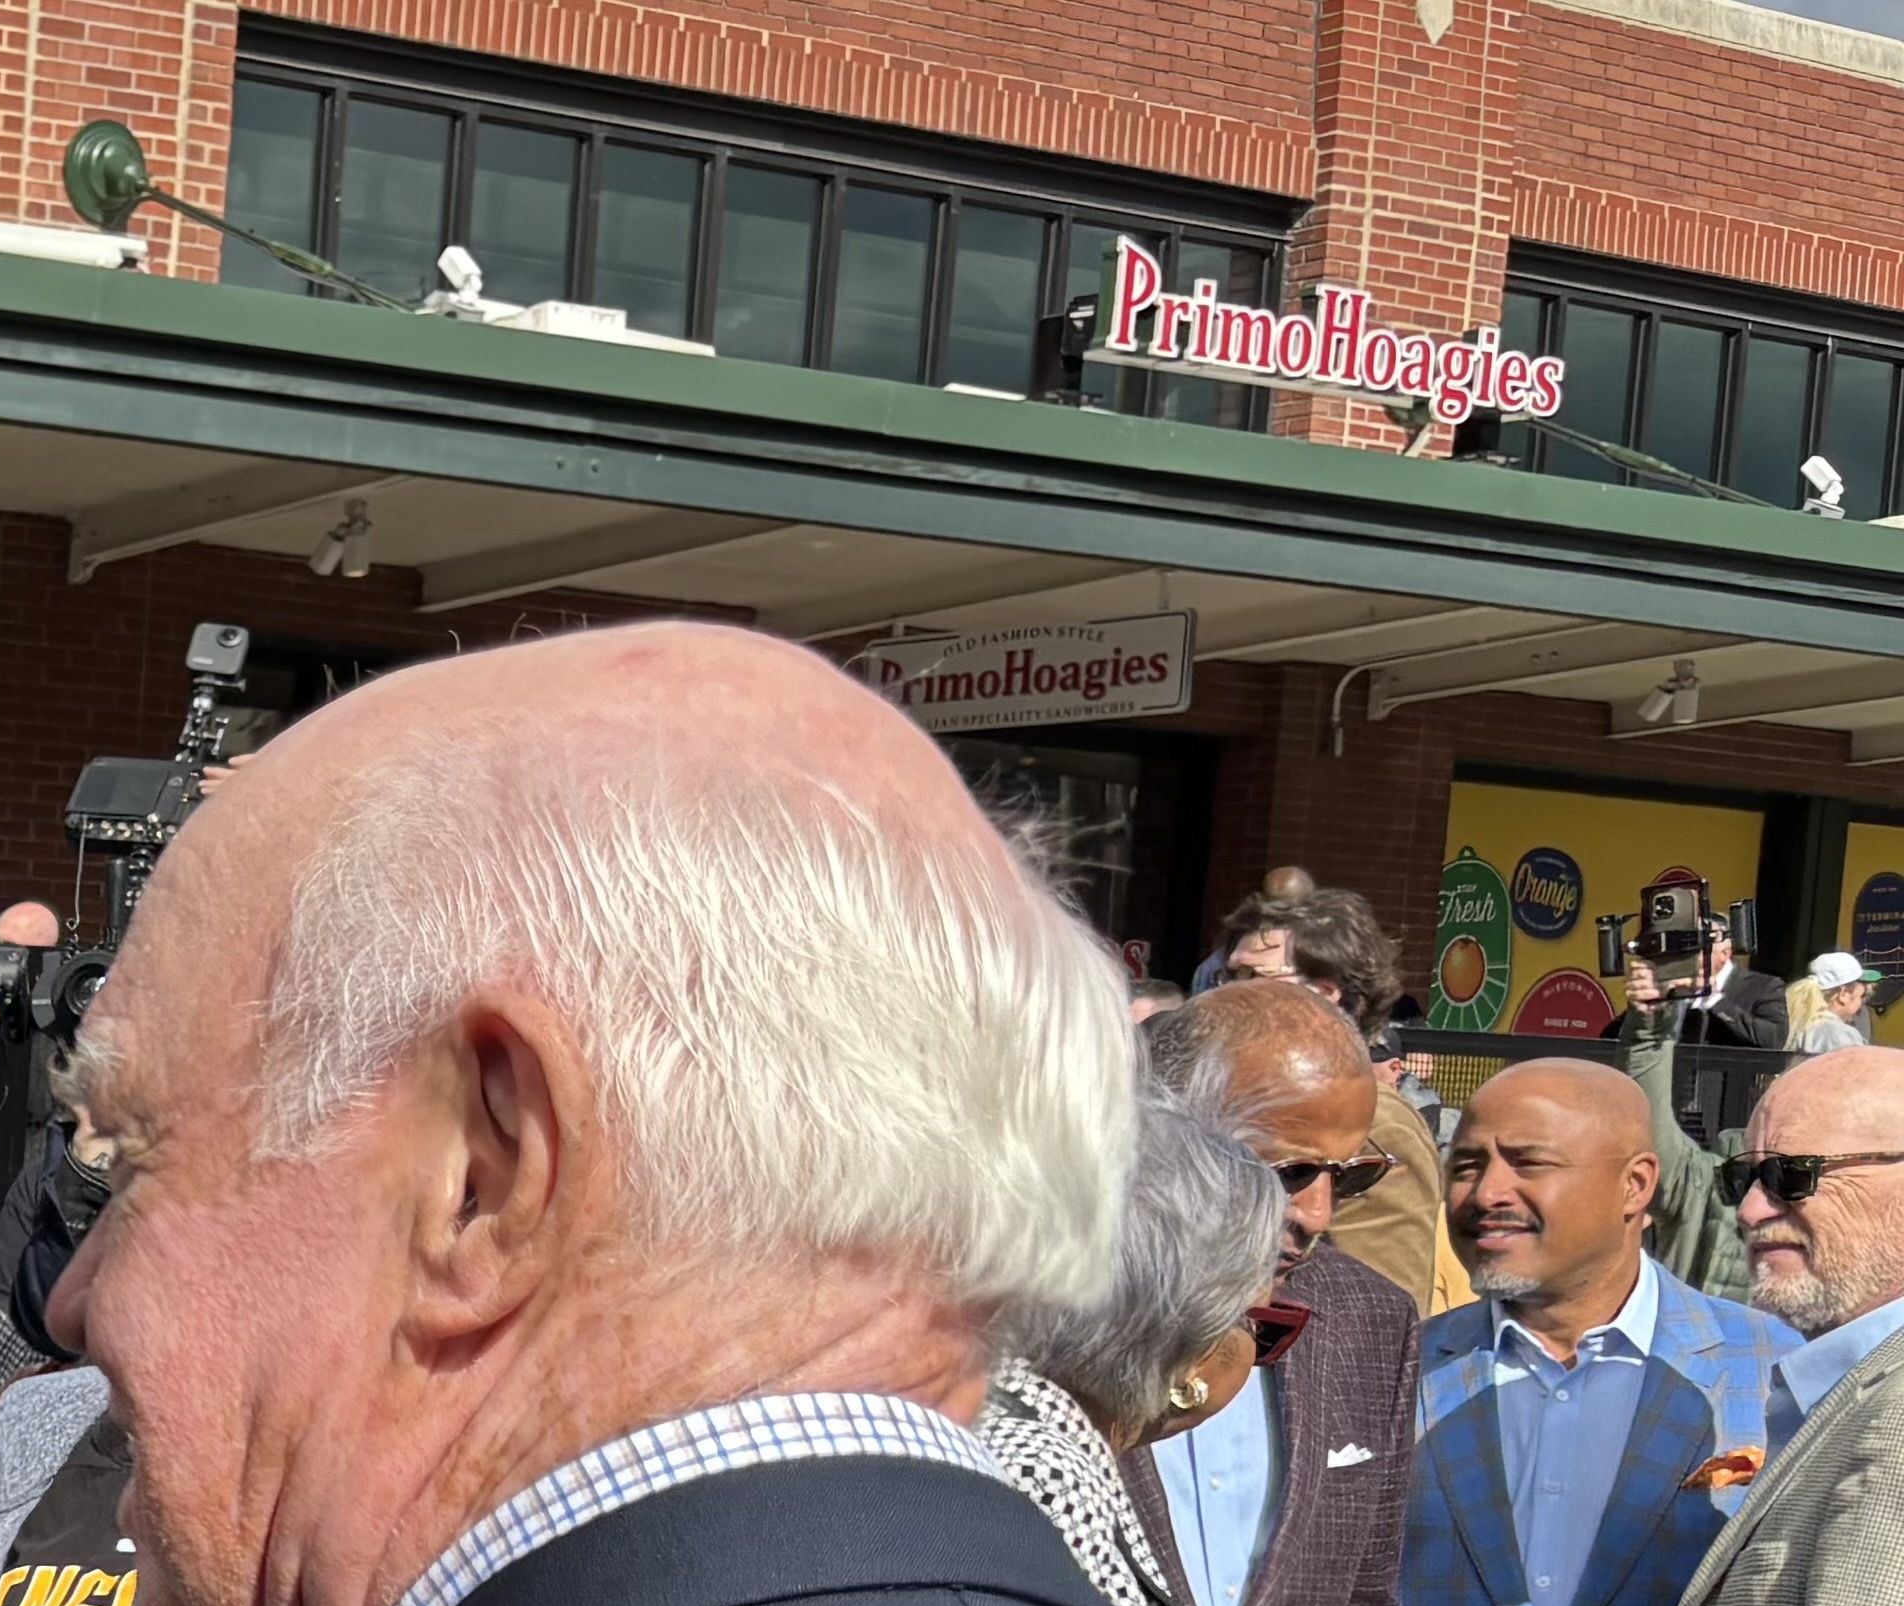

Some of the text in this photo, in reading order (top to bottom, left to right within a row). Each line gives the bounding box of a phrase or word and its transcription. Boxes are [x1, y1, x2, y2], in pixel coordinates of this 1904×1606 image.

[1106, 235, 1564, 426] PrimoHoagies
[981, 626, 1052, 645] FASHION
[1057, 626, 1106, 644] STYLE
[880, 647, 1169, 707] PrimoHoagies
[1045, 701, 1136, 719] SANDWICHES
[1438, 888, 1496, 928] Fresh
[1515, 862, 1578, 918] Orange
